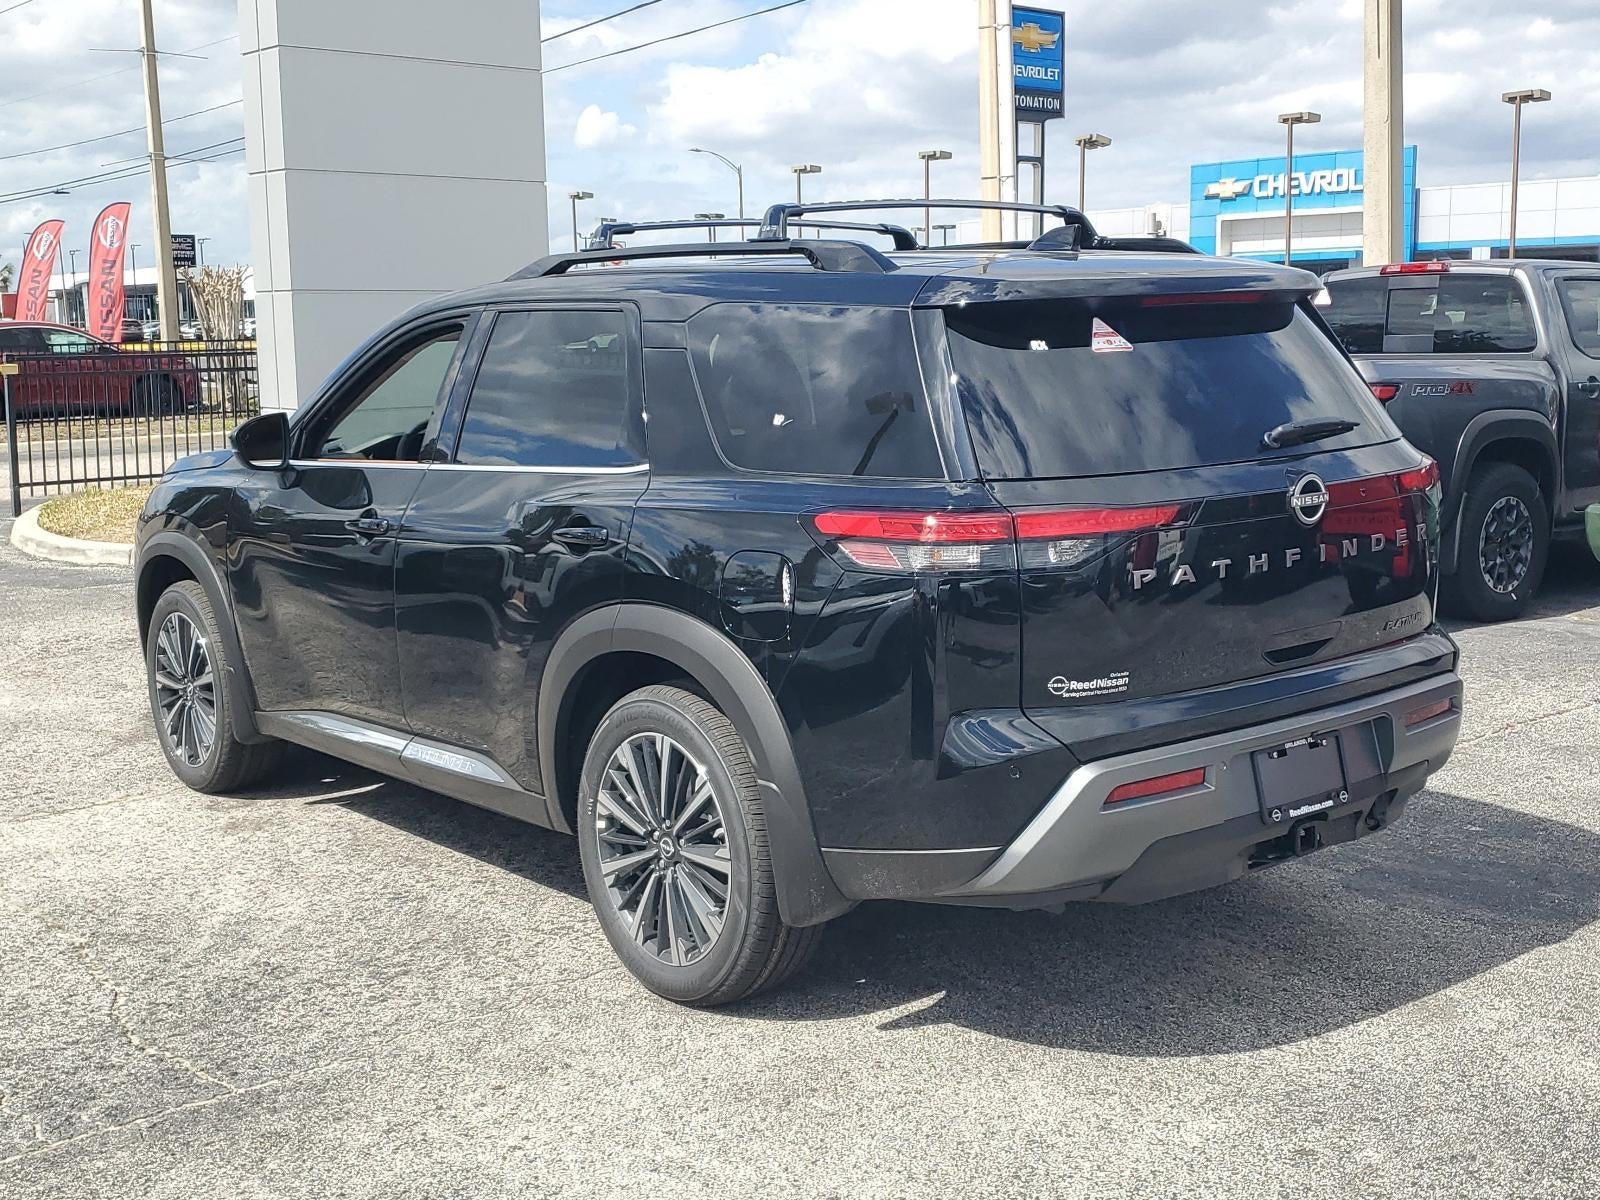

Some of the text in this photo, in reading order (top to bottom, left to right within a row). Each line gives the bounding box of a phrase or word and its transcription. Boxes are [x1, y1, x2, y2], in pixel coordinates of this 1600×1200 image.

[109, 218, 117, 247] NISSAN
[1293, 494, 1329, 506] NISSAN
[1133, 523, 1429, 590] PATHFINDER
